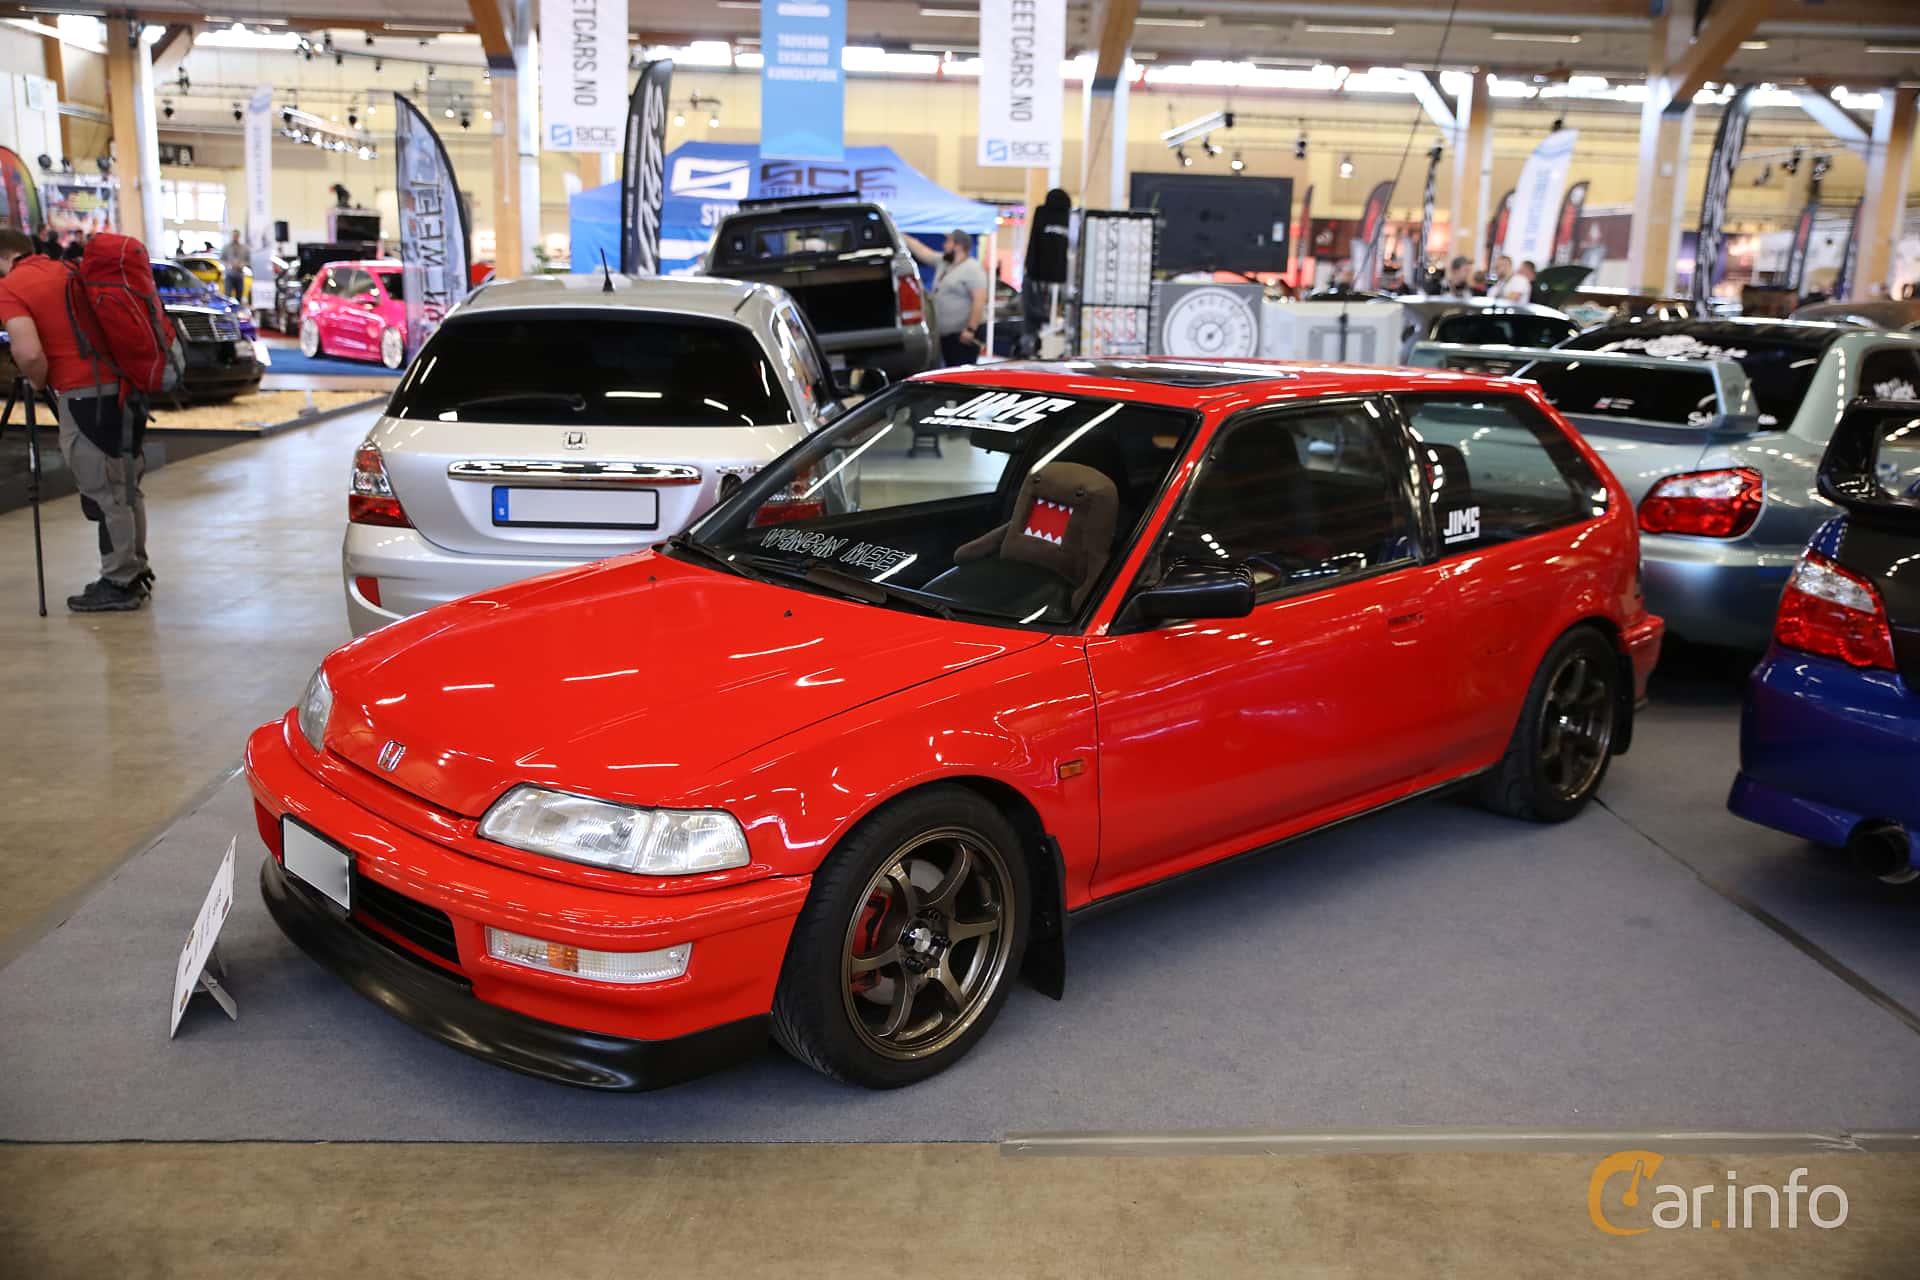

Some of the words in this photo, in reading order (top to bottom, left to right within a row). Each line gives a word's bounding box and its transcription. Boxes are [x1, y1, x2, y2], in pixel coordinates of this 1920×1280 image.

[932, 392, 1077, 432] JIMS
[1443, 506, 1480, 541] JIMS
[760, 527, 849, 558] WANGAN
